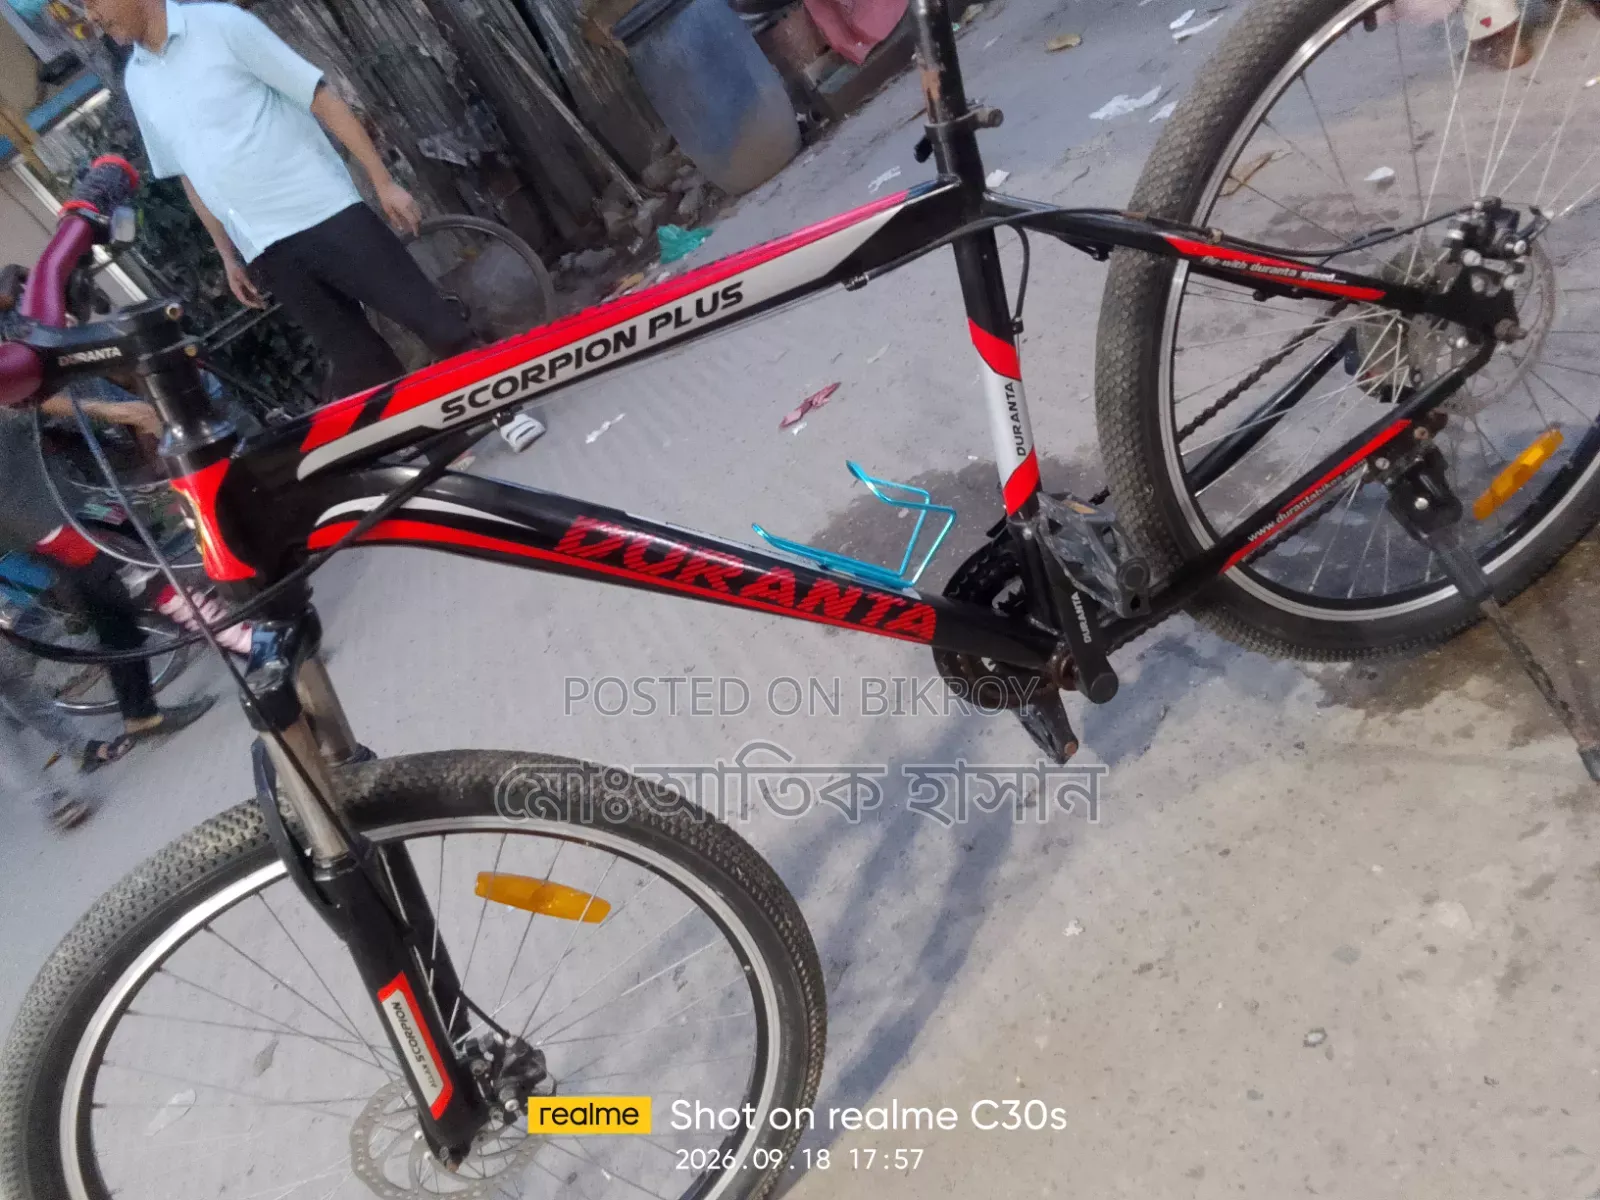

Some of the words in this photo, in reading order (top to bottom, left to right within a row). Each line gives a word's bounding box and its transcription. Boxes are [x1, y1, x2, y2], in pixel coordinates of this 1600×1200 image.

[1250, 263, 1298, 277] duranta
[58, 346, 123, 366] DURANTA
[440, 325, 637, 423] SCORPION
[648, 280, 744, 340] PLUS
[1004, 382, 1027, 456] DURANTA
[555, 514, 938, 641] DURANTA
[1071, 591, 1092, 644] DURANTA
[391, 1001, 425, 1063] SCORPION
